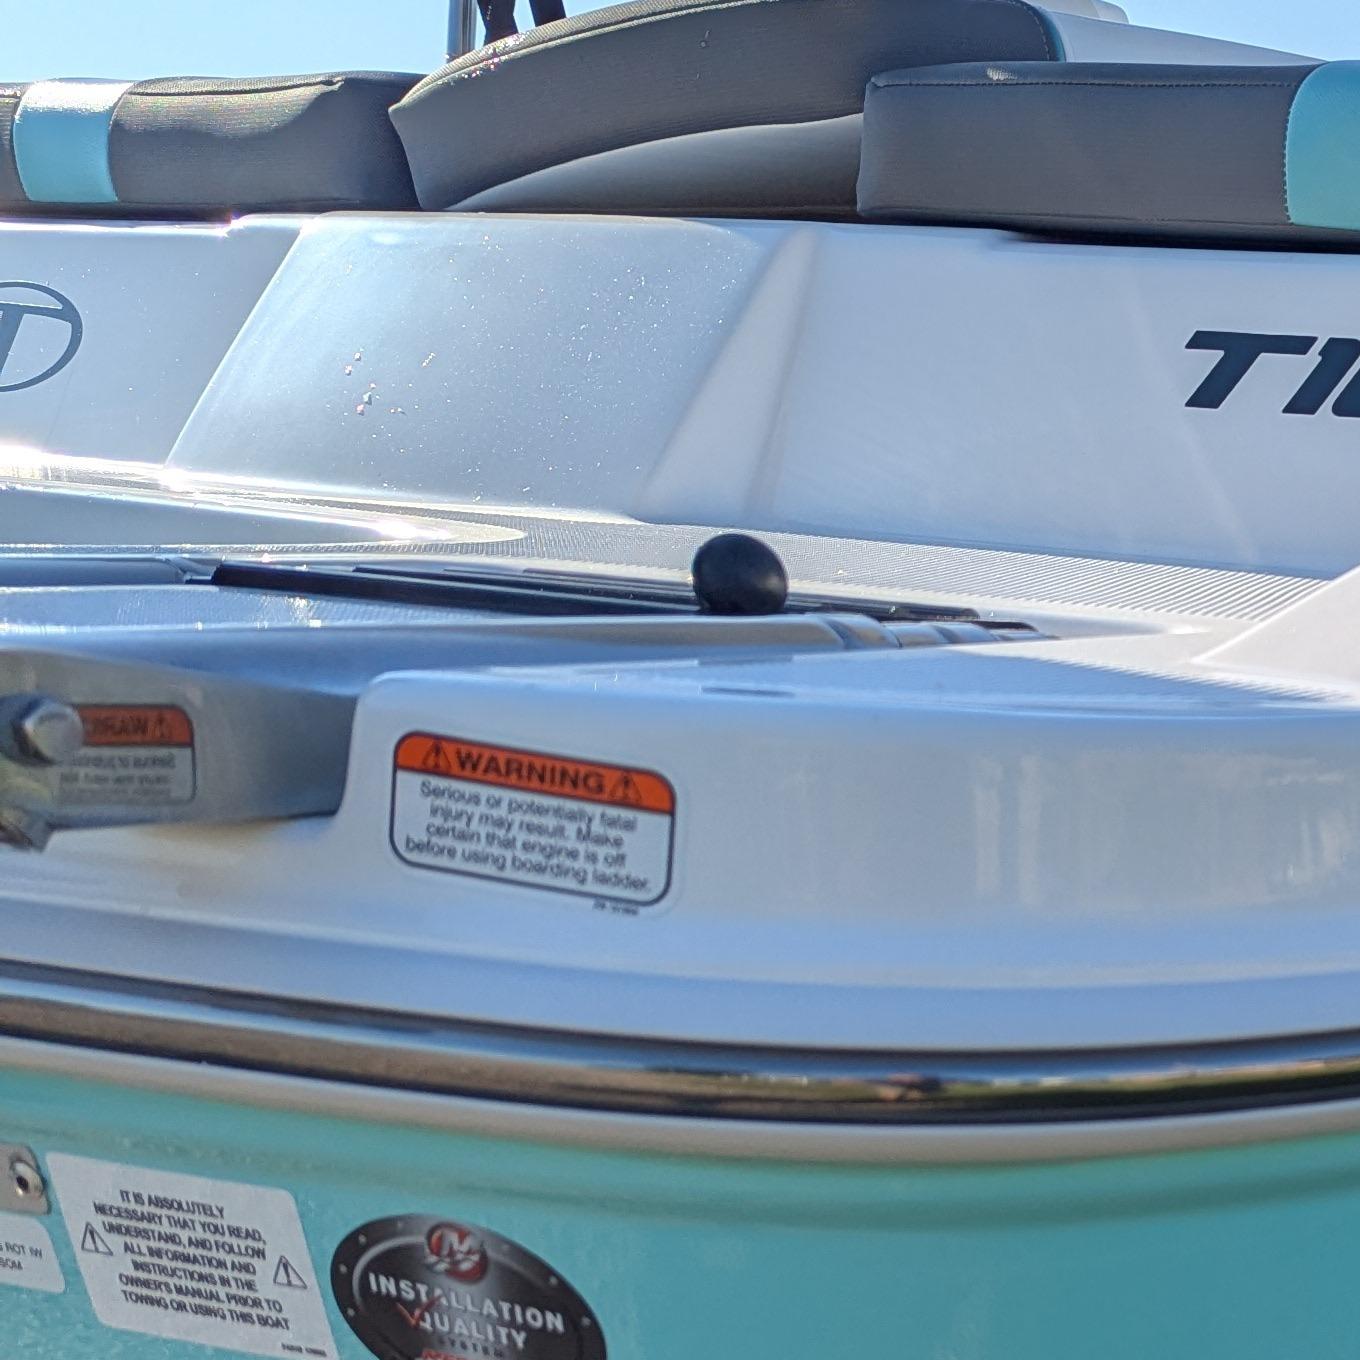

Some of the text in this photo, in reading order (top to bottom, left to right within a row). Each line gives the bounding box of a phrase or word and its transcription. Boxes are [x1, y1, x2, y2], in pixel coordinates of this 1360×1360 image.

[456, 748, 606, 795] WARNING
[420, 779, 637, 832] Serious or potentially fatal
[429, 801, 624, 848] injury may result. Make
[405, 835, 457, 858] before
[461, 848, 506, 871] using
[511, 853, 588, 885] boarding
[426, 823, 627, 868] certain that engine is off
[93, 1201, 267, 1245] NECESSARY THAT YOU READ,
[120, 1189, 225, 1219] IT IS ABSOLUTELY
[103, 1220, 267, 1261] UNDERSTAND, AND FOLLOW
[123, 1241, 256, 1276] ALL INFORMATION AND
[118, 1272, 283, 1313] OWNER'S MANUAL PRIOR TO
[132, 1259, 258, 1292] INSTRUCTIONS IN THE
[121, 1290, 290, 1331] TOWING OR USING THIS BOAT
[368, 1272, 565, 1334] INSTALLATION
[420, 1310, 528, 1350] QUALITY
